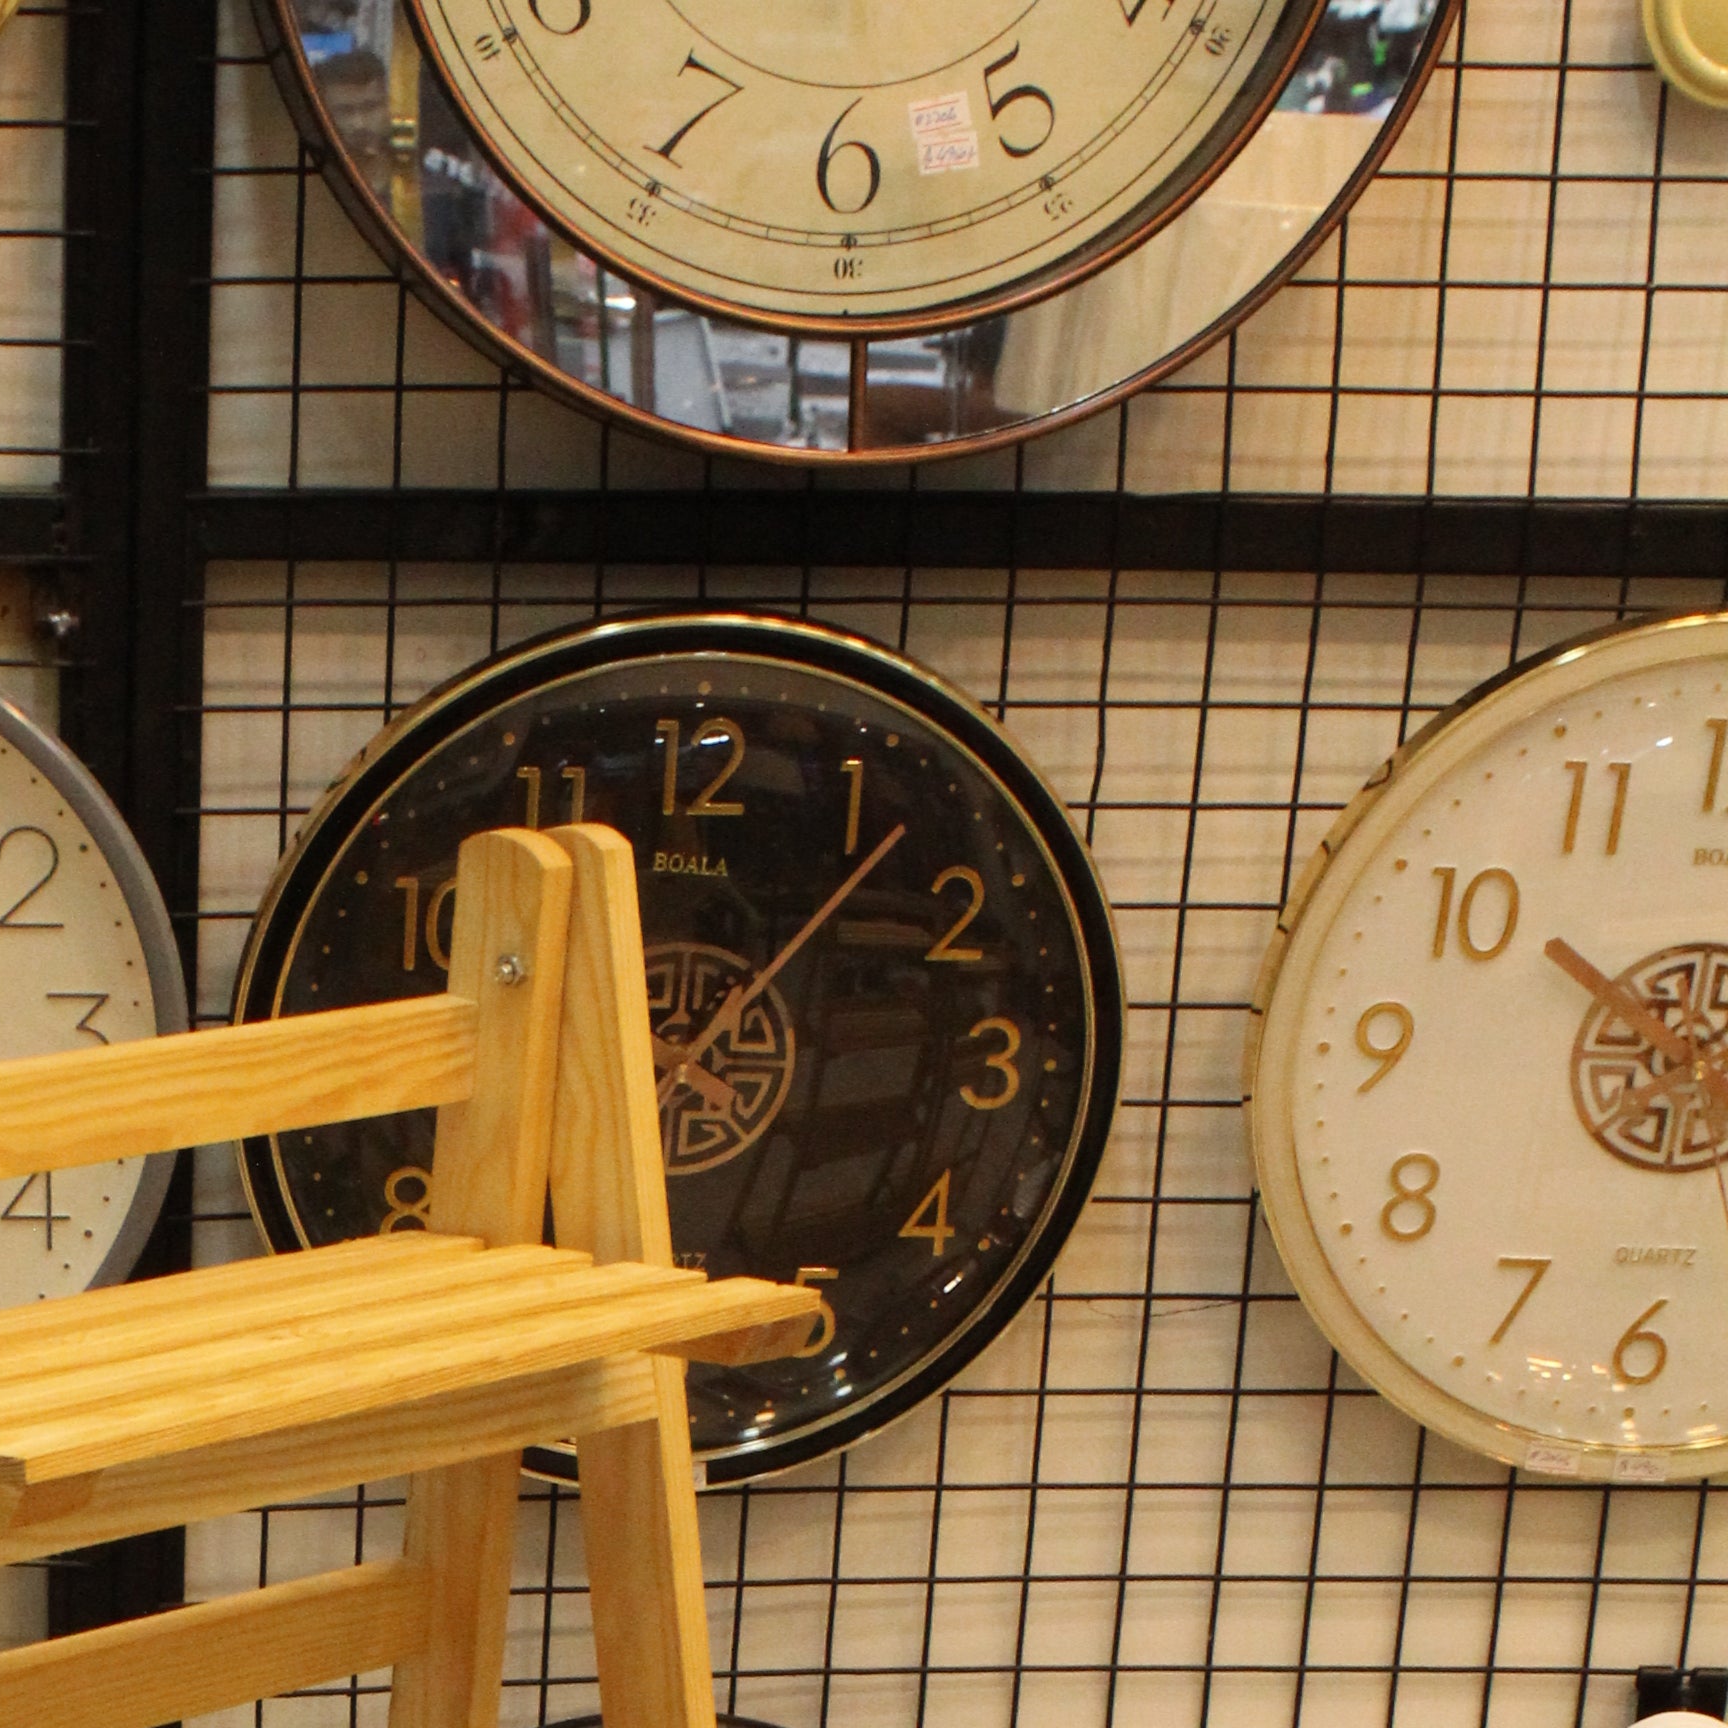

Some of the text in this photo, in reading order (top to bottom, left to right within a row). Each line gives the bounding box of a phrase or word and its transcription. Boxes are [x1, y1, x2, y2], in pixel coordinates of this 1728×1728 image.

[643, 49, 744, 169] 7
[984, 40, 1055, 158] 5
[817, 97, 881, 214] 6
[833, 257, 863, 280] 30
[656, 717, 746, 816] 12
[842, 758, 863, 855] 1
[1564, 761, 1632, 856] 11
[653, 851, 728, 877] BOALA
[925, 866, 986, 962] 2
[1431, 867, 1520, 961] 10
[959, 1017, 1021, 1111] 3
[1354, 1002, 1414, 1094] 9
[0, 1171, 70, 1250] 4
[899, 1169, 955, 1256] 4
[1380, 1153, 1441, 1243] 8
[1488, 1257, 1552, 1346] 7
[1614, 1246, 1696, 1266] QUARTZ
[1612, 1299, 1668, 1386] 6
